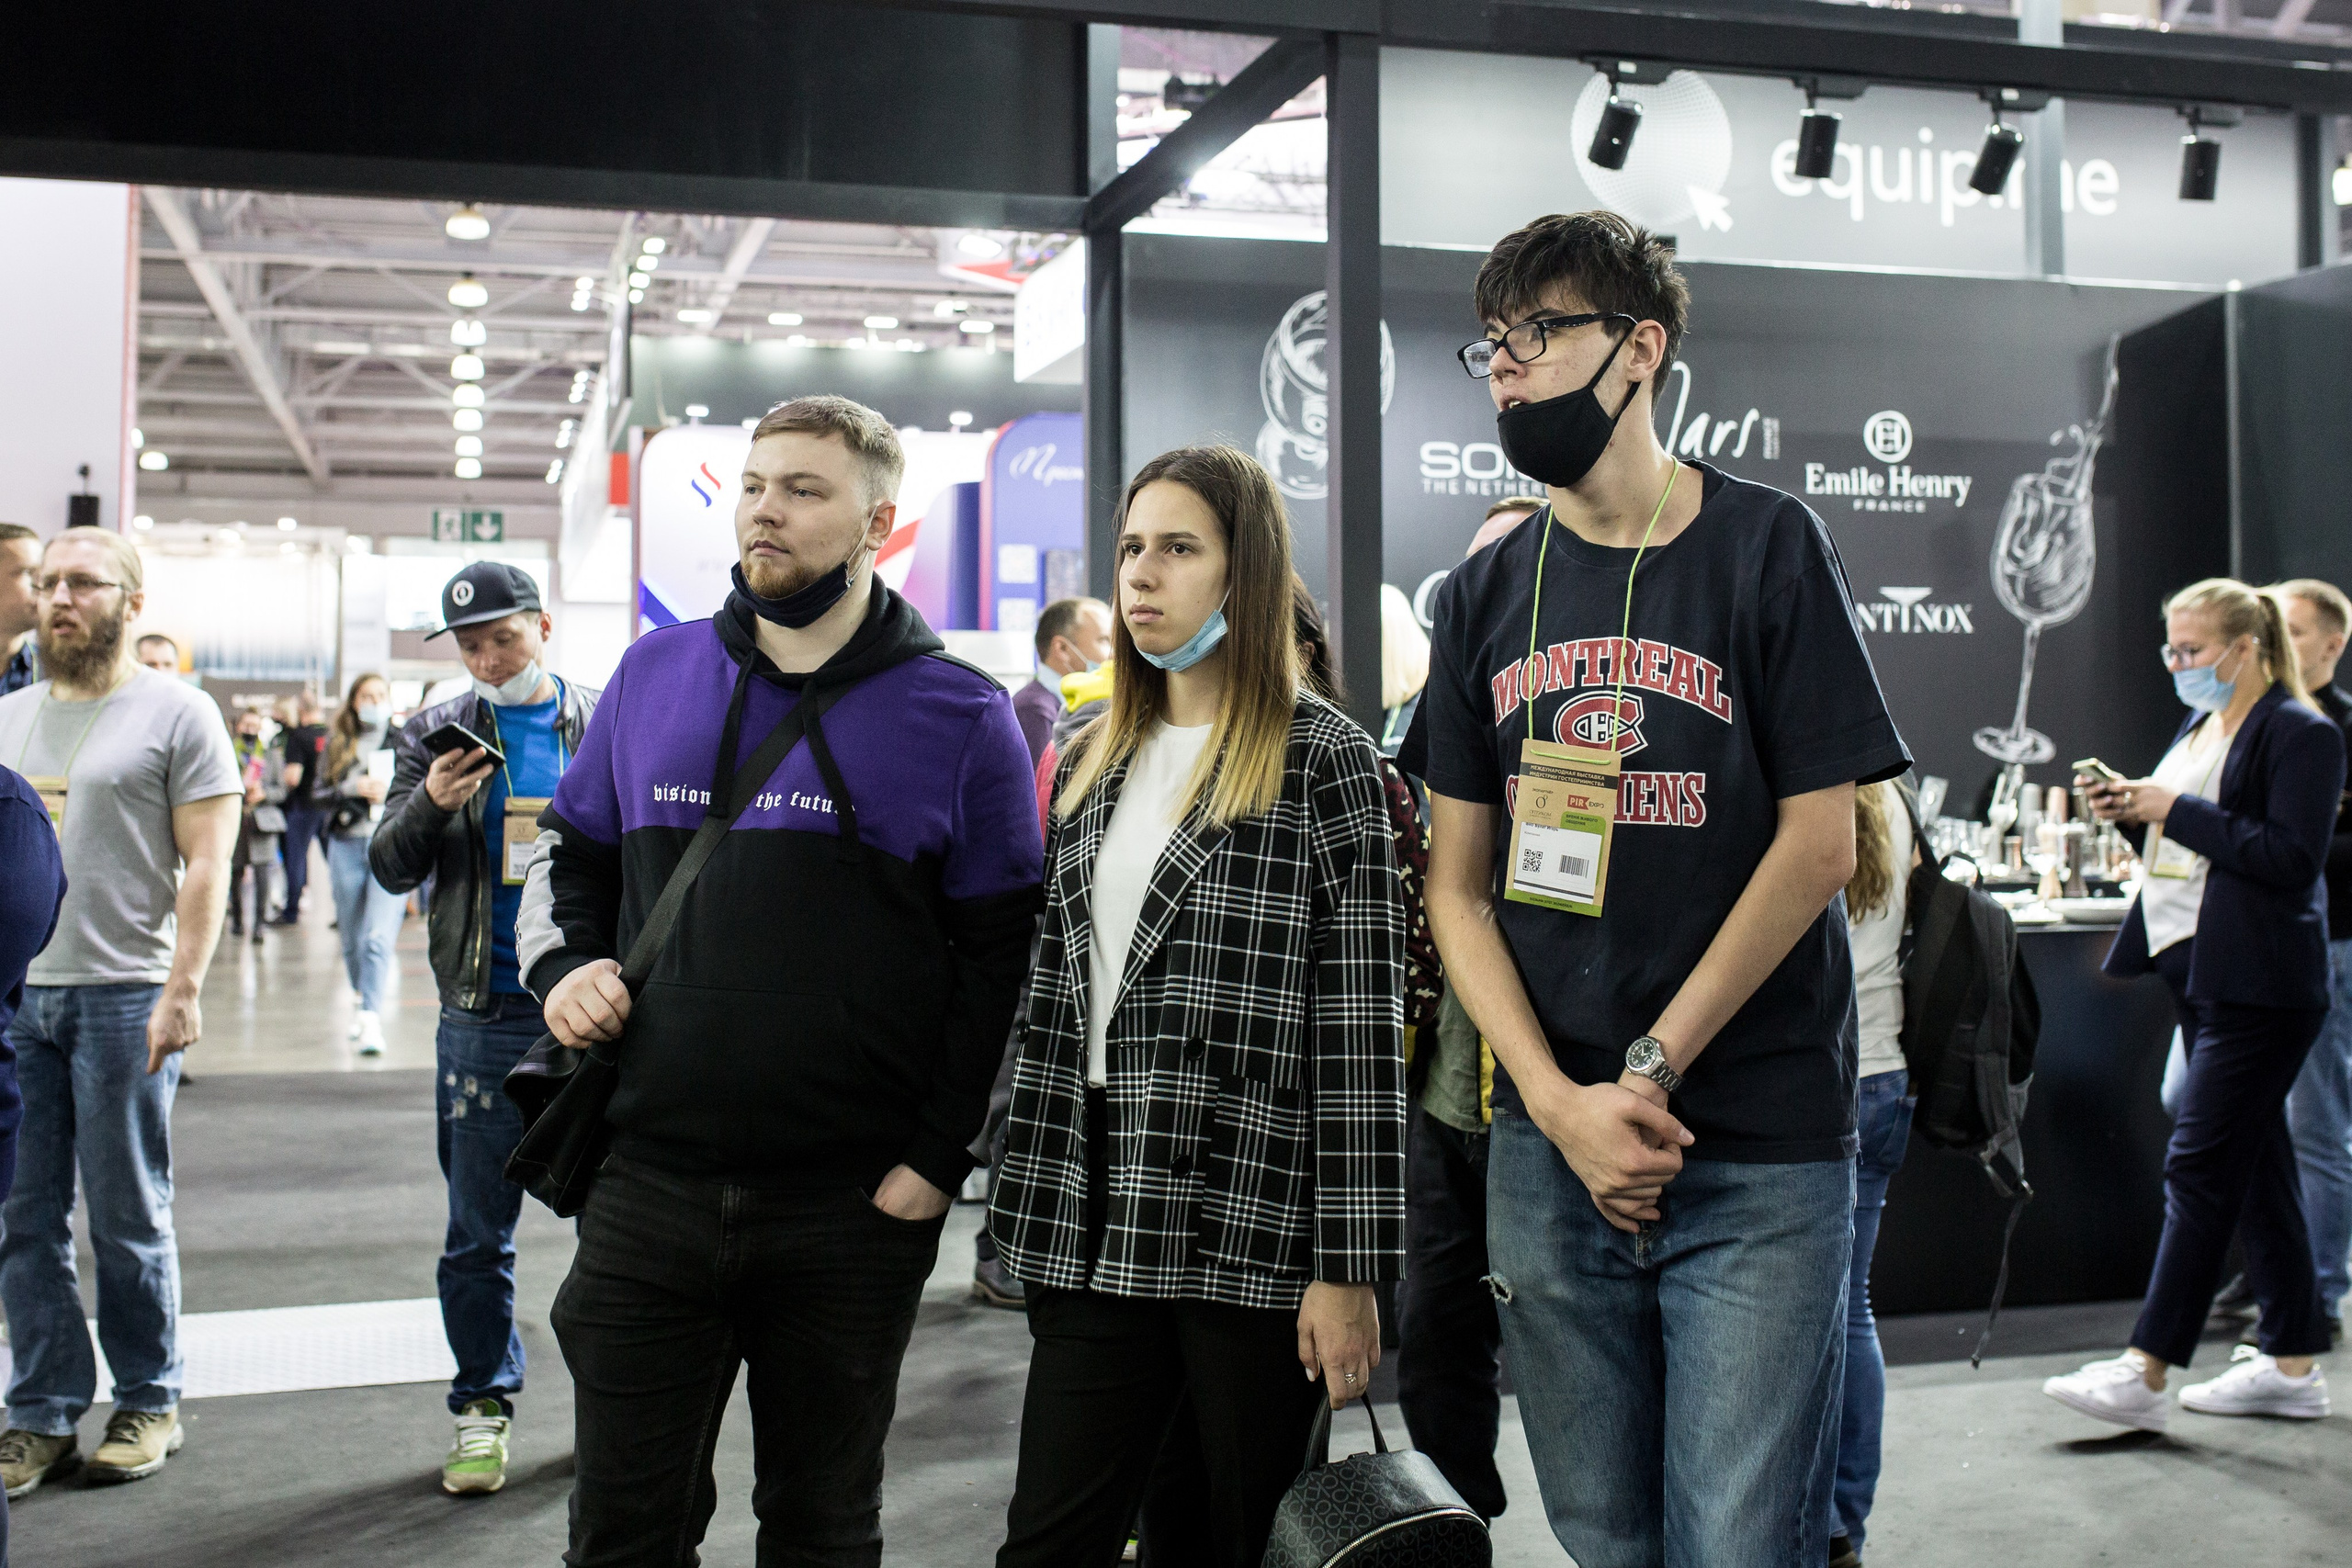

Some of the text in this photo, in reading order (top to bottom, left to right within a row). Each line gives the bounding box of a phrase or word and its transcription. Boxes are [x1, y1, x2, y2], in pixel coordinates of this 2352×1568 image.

[1422, 479, 1546, 497] THE NETHER
[1804, 462, 1973, 507] Emile Henry
[1852, 499, 1927, 513] FRANCE
[1856, 603, 1973, 634] NTINOX
[1491, 636, 1733, 728] MONTREAL
[755, 792, 782, 811] the
[1569, 796, 1585, 807] PIR
